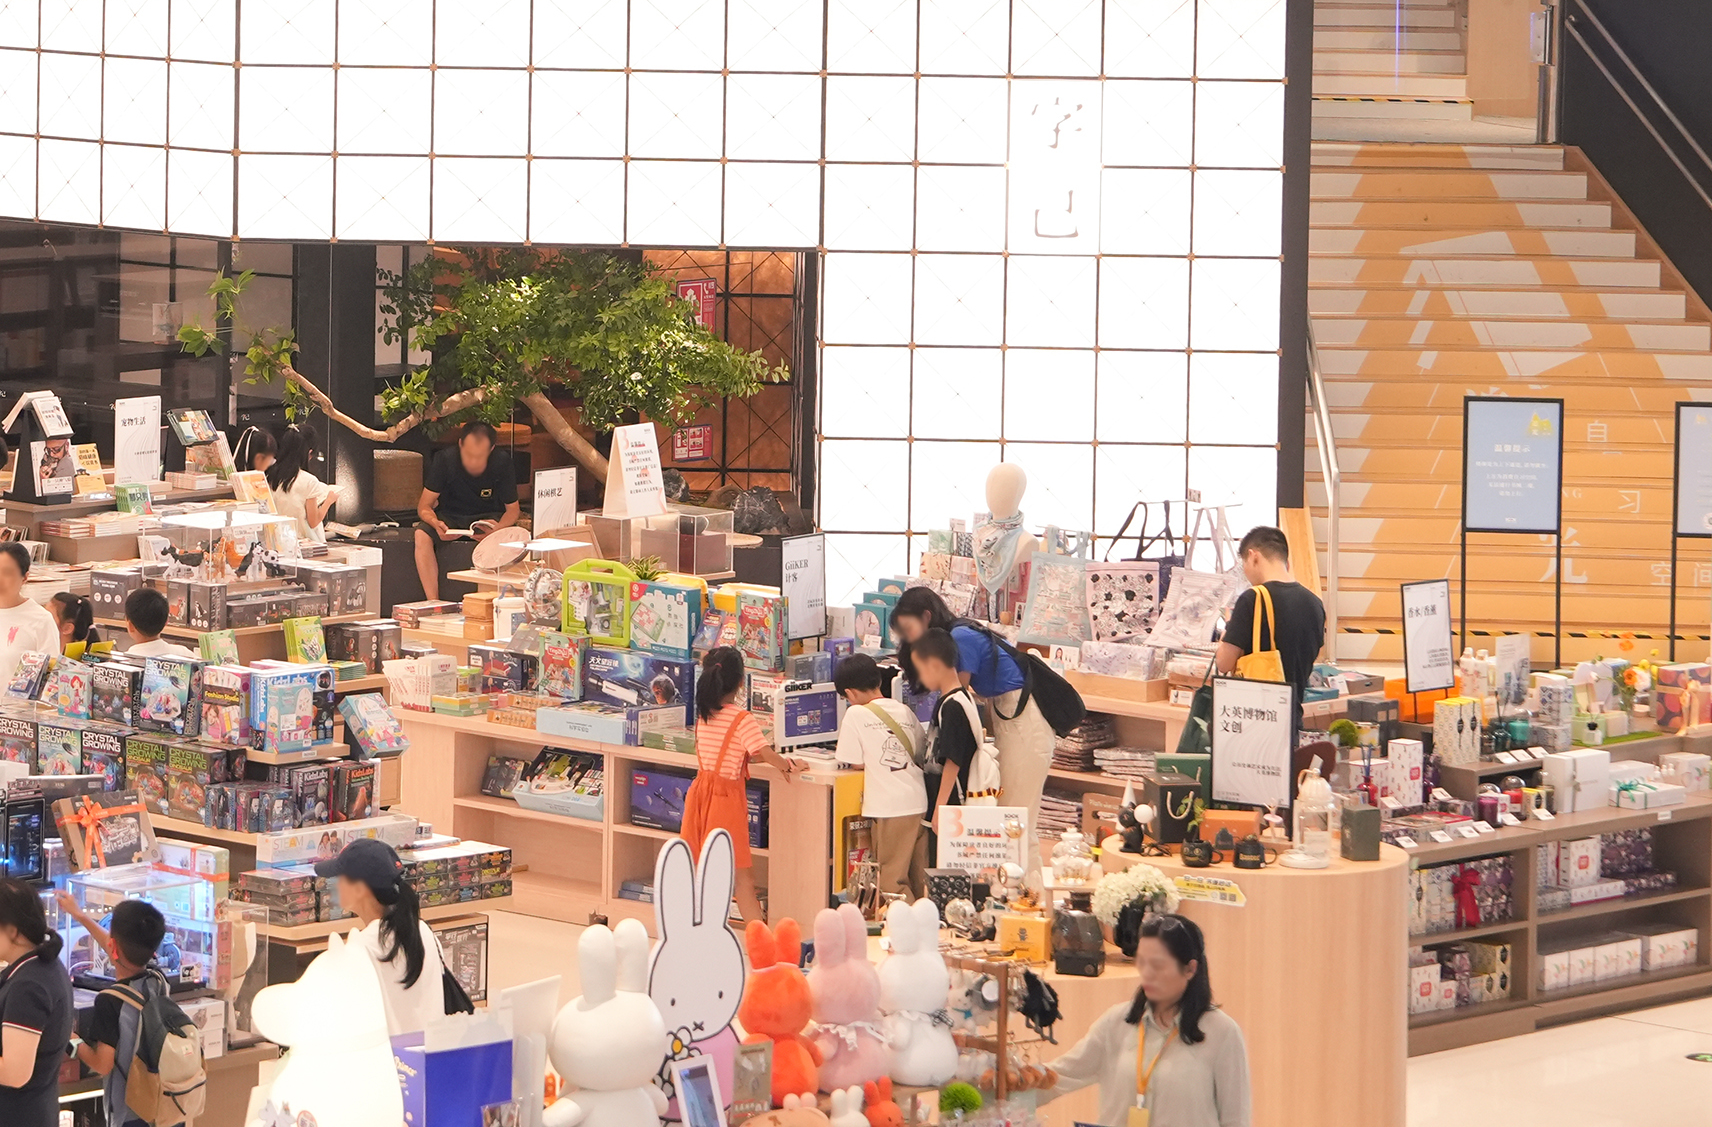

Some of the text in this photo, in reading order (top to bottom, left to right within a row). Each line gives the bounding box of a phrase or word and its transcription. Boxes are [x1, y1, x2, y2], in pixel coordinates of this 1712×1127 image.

[121, 416, 147, 427] 宠物生活
[1588, 419, 1608, 442] 自
[1494, 444, 1531, 453] 温馨提示
[538, 486, 563, 499] 休闲棋艺
[1618, 489, 1640, 514] 习
[145, 665, 187, 680] GROWING
[146, 657, 187, 673] CRYSTAL
[93, 665, 129, 681] CRYSTAL
[93, 674, 129, 689] GROWING
[204, 690, 240, 702] Fashion Studio
[1219, 704, 1278, 723] 大英博物馆
[38, 724, 78, 741] CRYSTAL
[1220, 720, 1243, 734] 文创
[38, 732, 78, 747] GROWING
[82, 730, 122, 746] CRYSTAL
[82, 738, 122, 753] GROWING
[126, 739, 166, 755] CRYSTAL
[126, 747, 166, 762] GROWING
[169, 747, 207, 763] CRYSTAL
[169, 755, 207, 771] GROWING
[303, 771, 329, 781] KidzLabs
[351, 768, 374, 778] KidzLabs
[273, 835, 304, 851] STEAM
